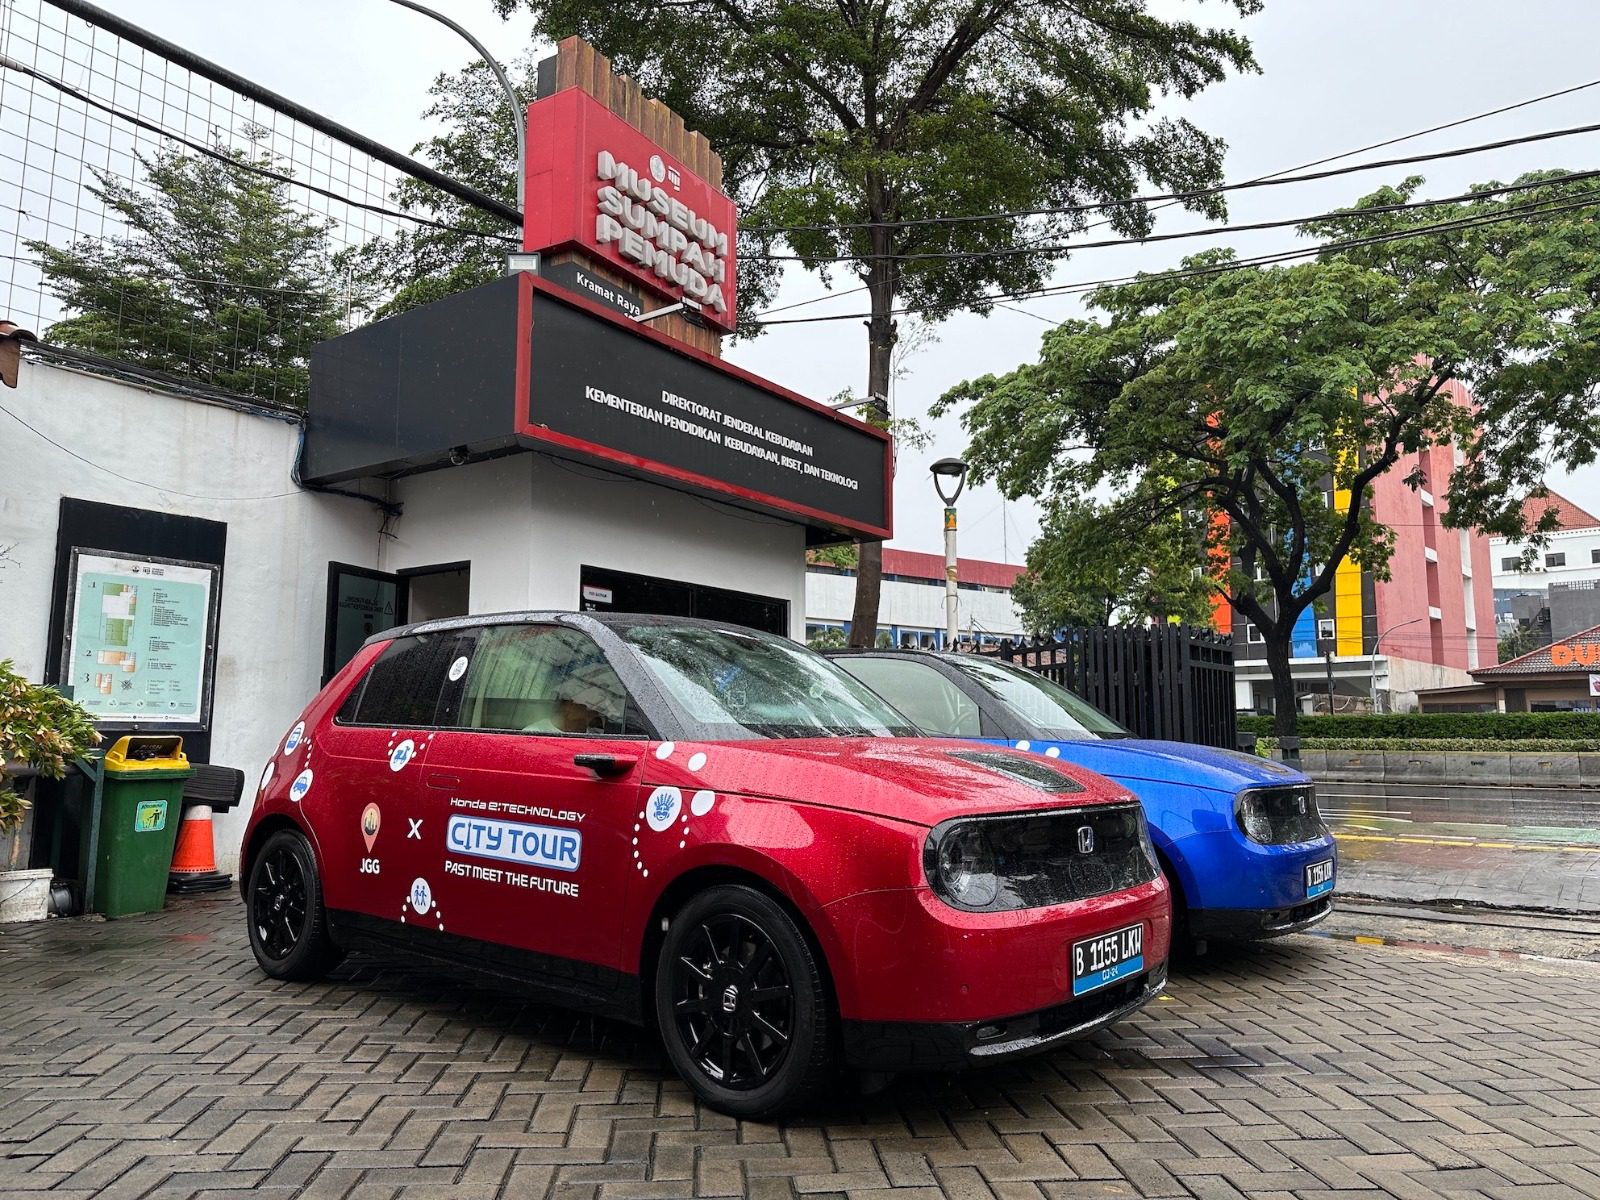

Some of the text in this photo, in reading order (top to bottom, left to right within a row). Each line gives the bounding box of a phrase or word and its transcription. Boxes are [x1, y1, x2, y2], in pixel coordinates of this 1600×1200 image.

[597, 150, 728, 257] MUSEUM
[597, 185, 726, 284] SUMPAH
[596, 213, 728, 313] PEMUDA
[576, 272, 640, 315] Kramat Raya
[585, 385, 859, 490] KEMENTERIAN PENDIDIKAN KEBUDAYAAN, RISET, DAN TEKNOLOGI
[661, 390, 813, 457] DIREKTORAT JENDERAL KEBUDAYAAN
[1551, 643, 1600, 666] DU
[450, 797, 487, 811] Honda
[360, 858, 380, 874] JGG
[508, 829, 577, 863] TOUR
[444, 860, 580, 897] PAST MEET THE FUTURE
[1076, 947, 1084, 976] B
[1090, 935, 1118, 972] 1155
